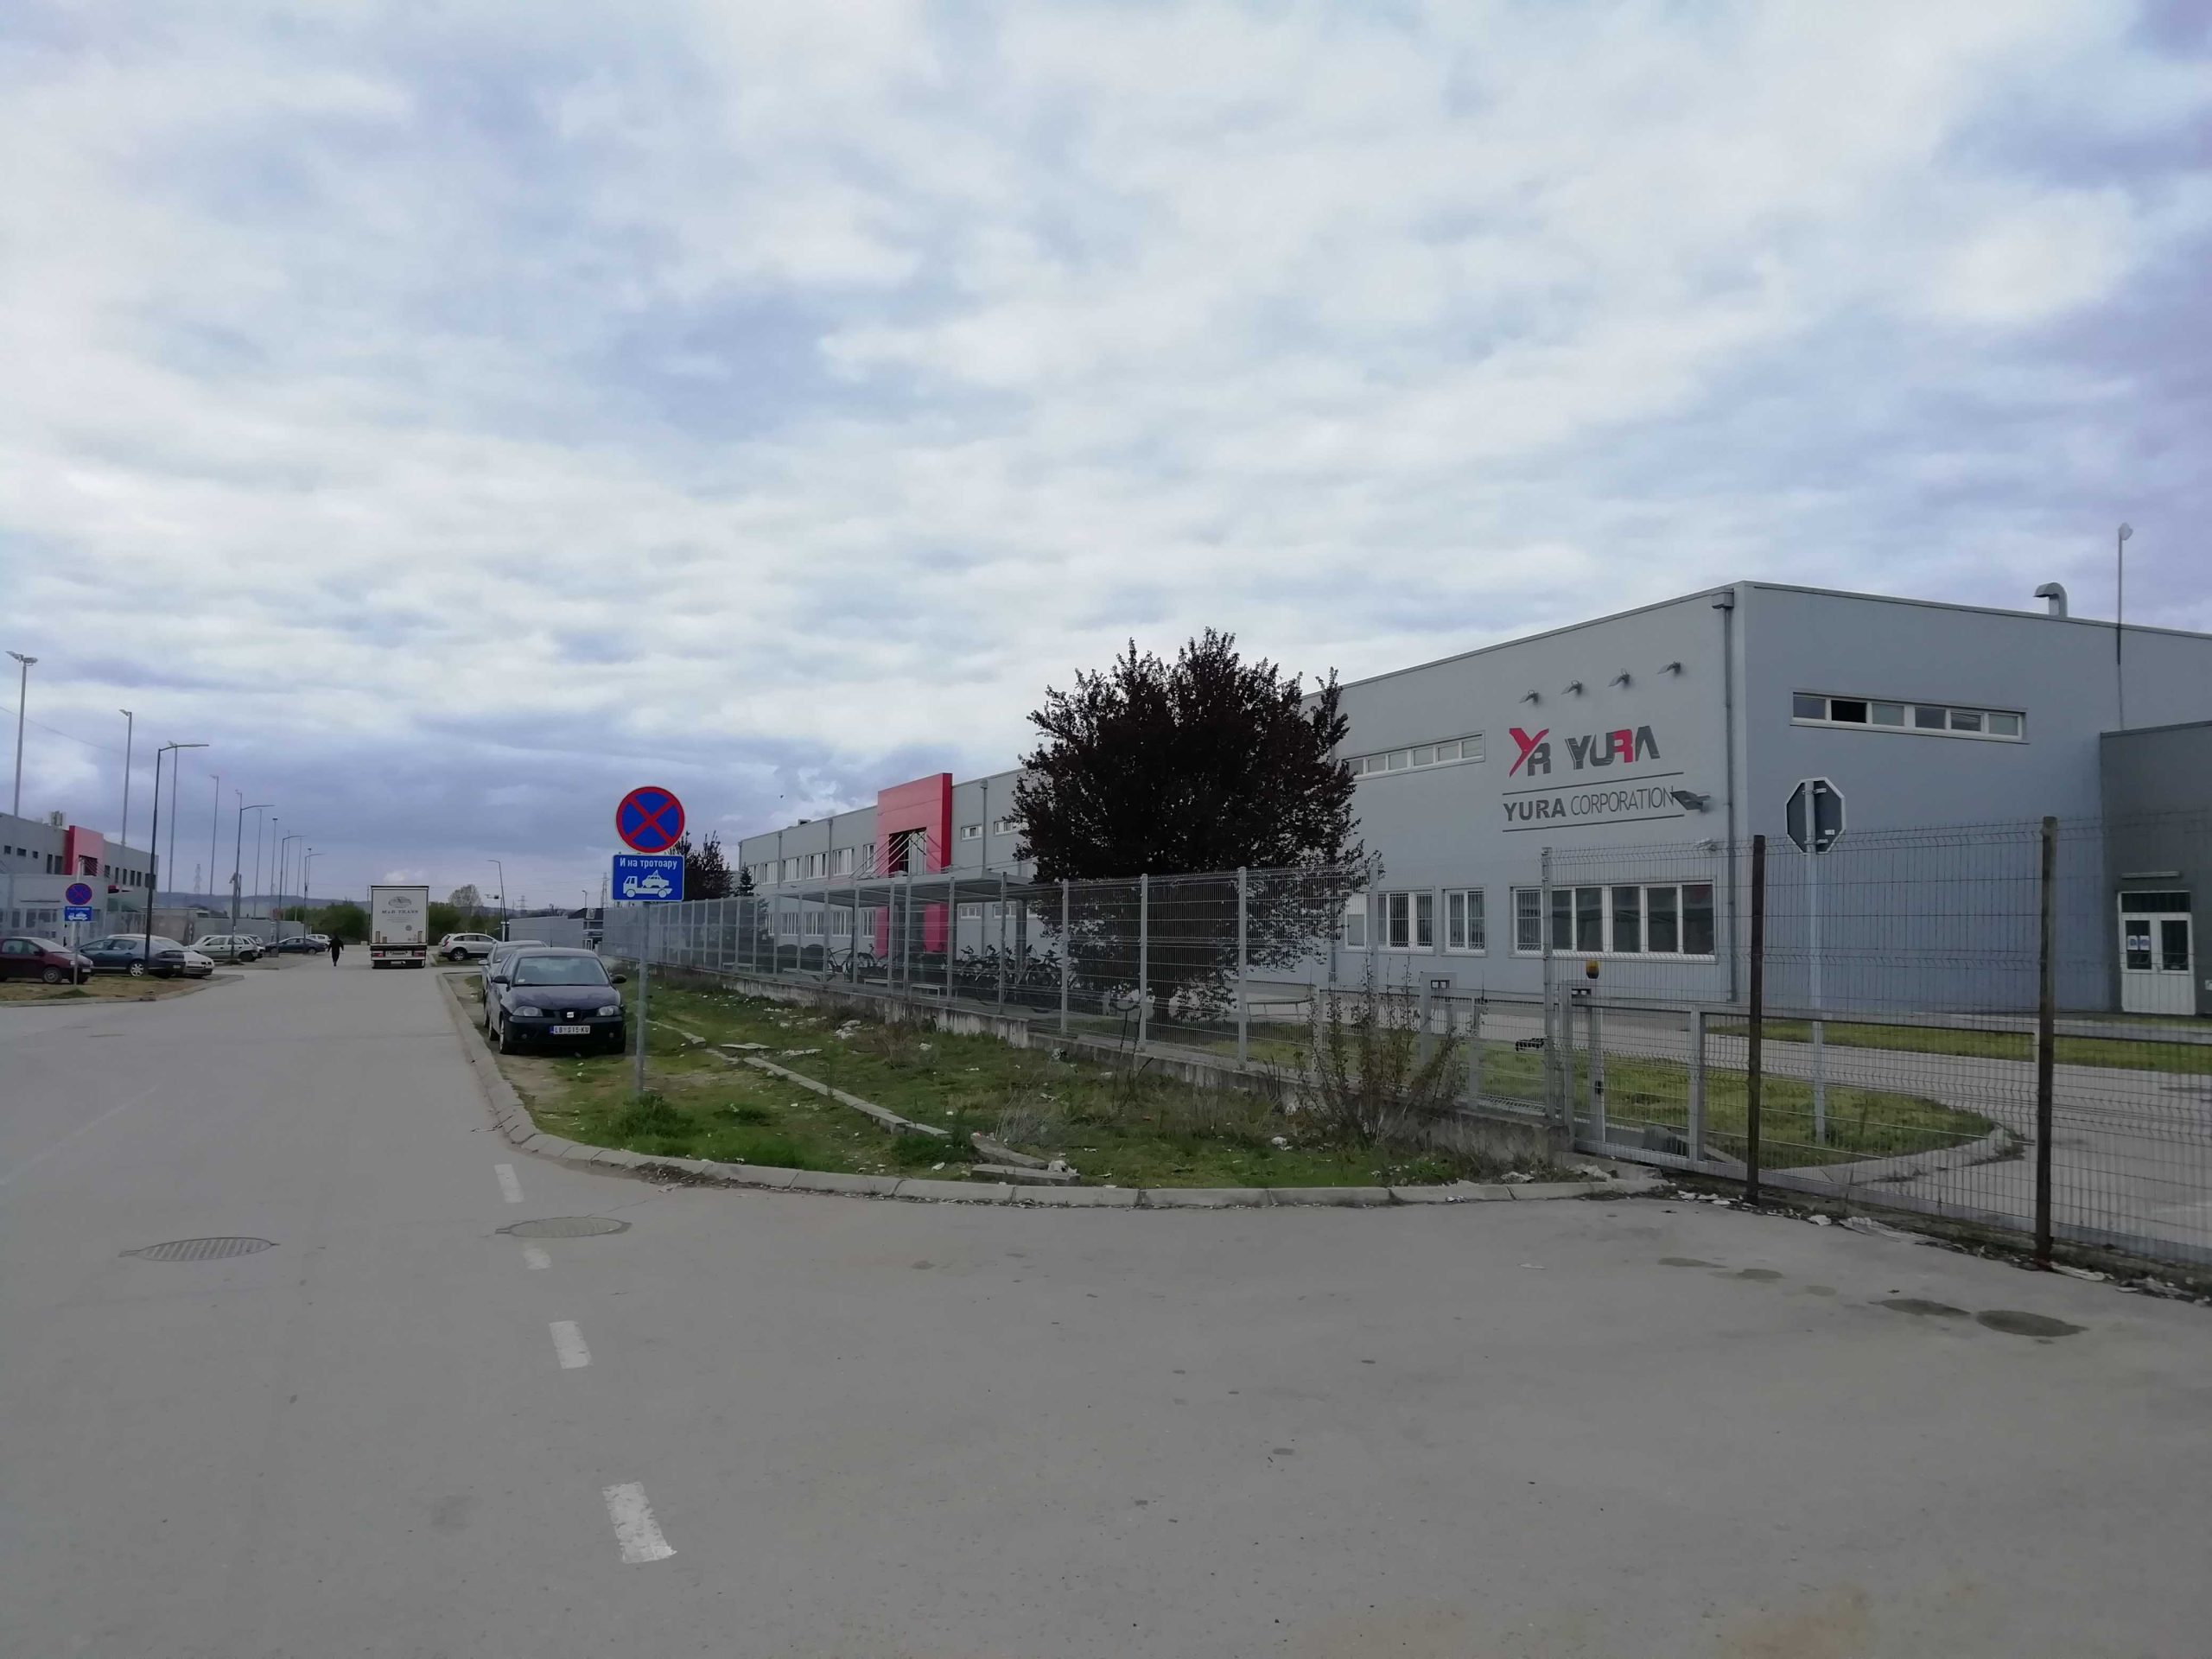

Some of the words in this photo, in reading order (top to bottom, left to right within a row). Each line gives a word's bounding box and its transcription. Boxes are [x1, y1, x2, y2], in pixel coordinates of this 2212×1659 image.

[1565, 725, 1661, 770] YURA
[1503, 798, 1567, 822] YURA
[1570, 785, 1675, 816] CORPORATION
[620, 857, 626, 868] И
[640, 859, 677, 870] тротоару
